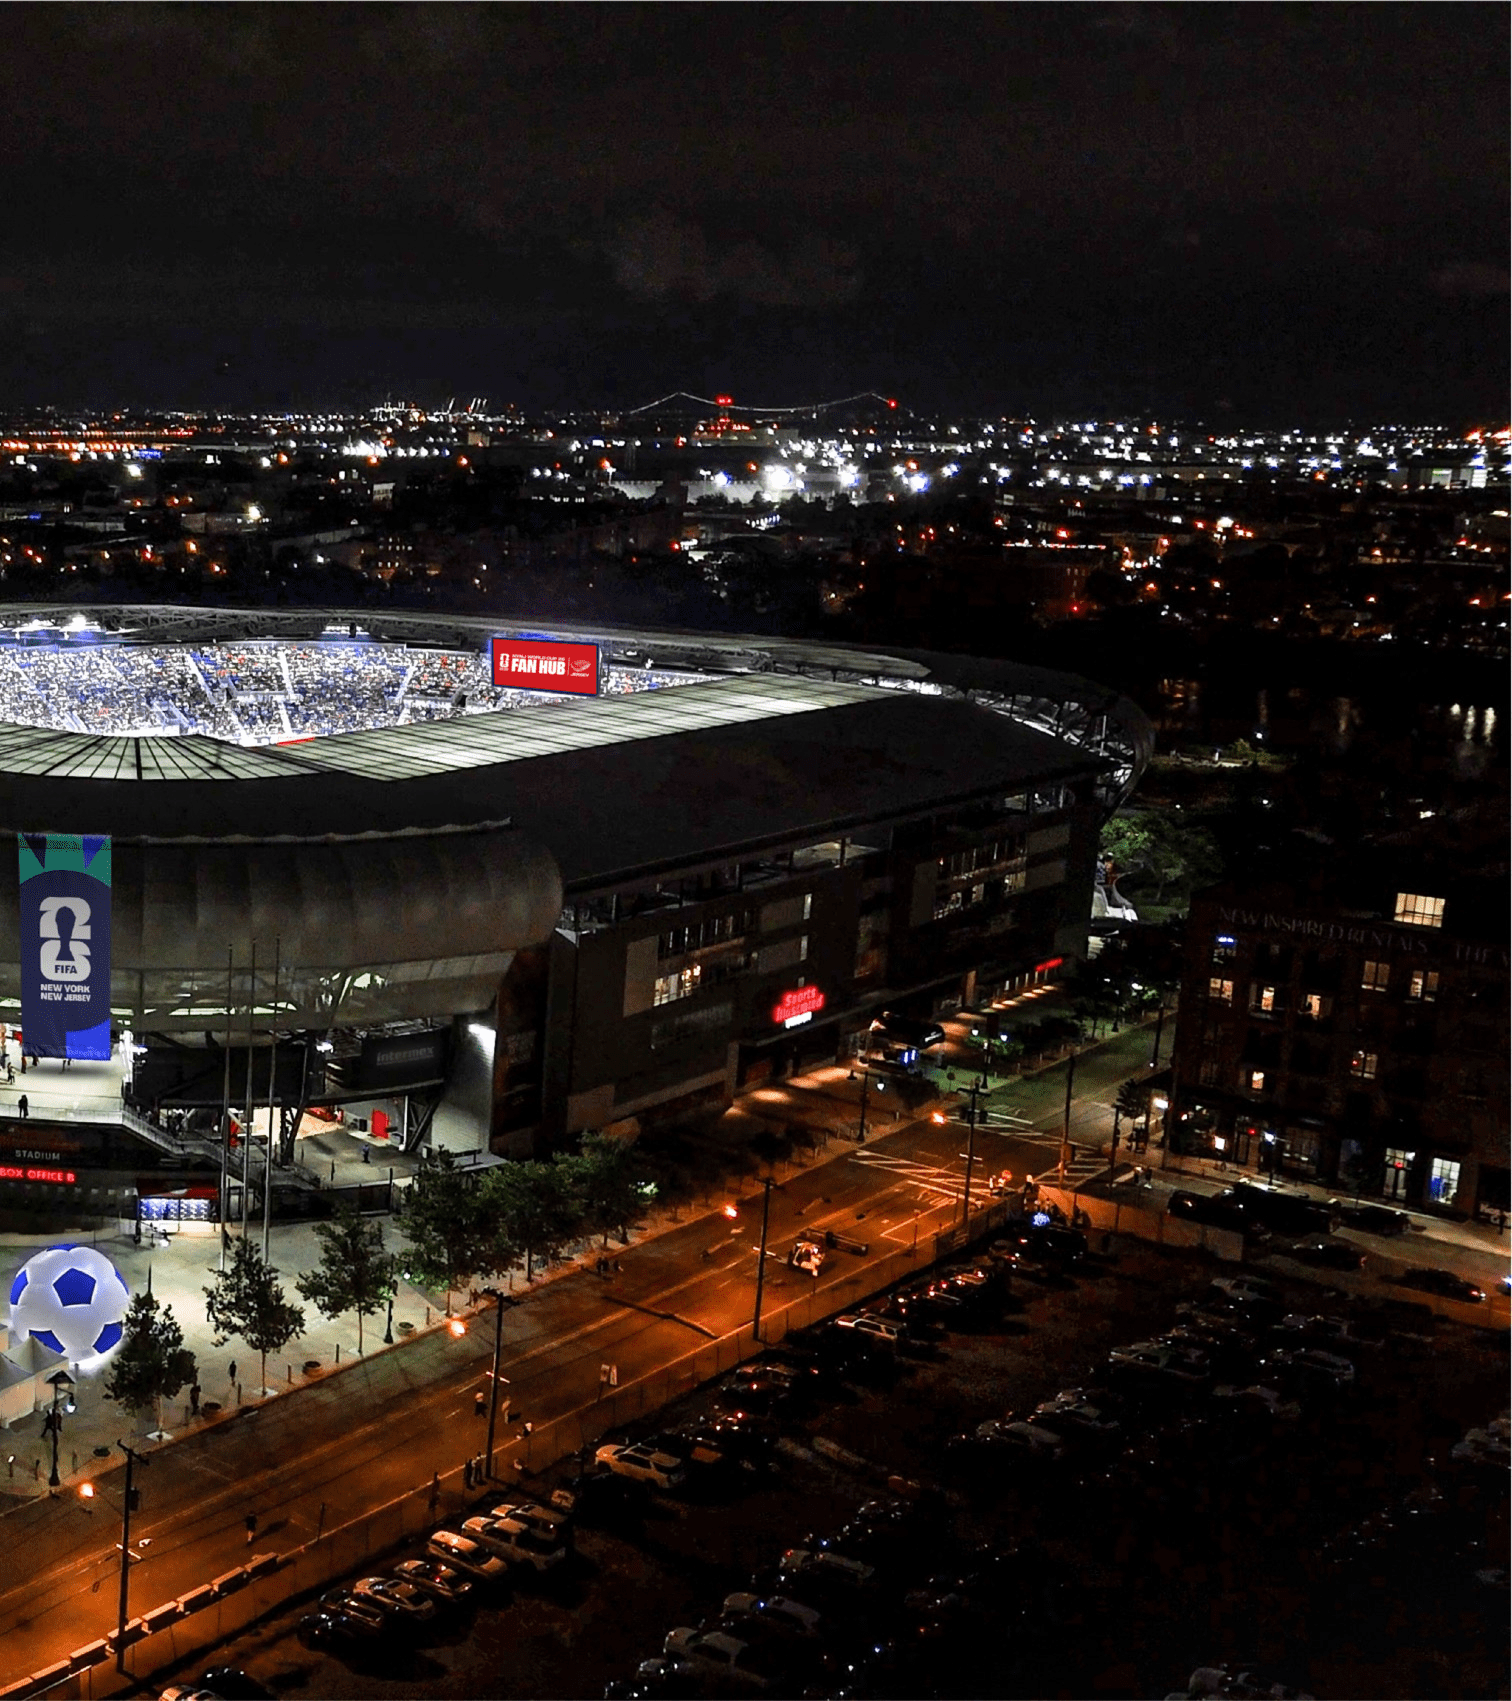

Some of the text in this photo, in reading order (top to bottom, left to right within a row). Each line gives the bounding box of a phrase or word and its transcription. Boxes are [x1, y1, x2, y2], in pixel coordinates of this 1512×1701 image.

[511, 658, 566, 676] FAN HUB
[54, 965, 78, 974] FIFA
[40, 983, 90, 993] NEW YORK
[40, 993, 91, 1002] NEW JERSEY
[14, 1149, 61, 1160] STADIUM
[0, 1166, 75, 1183] BOX OFFICE B
